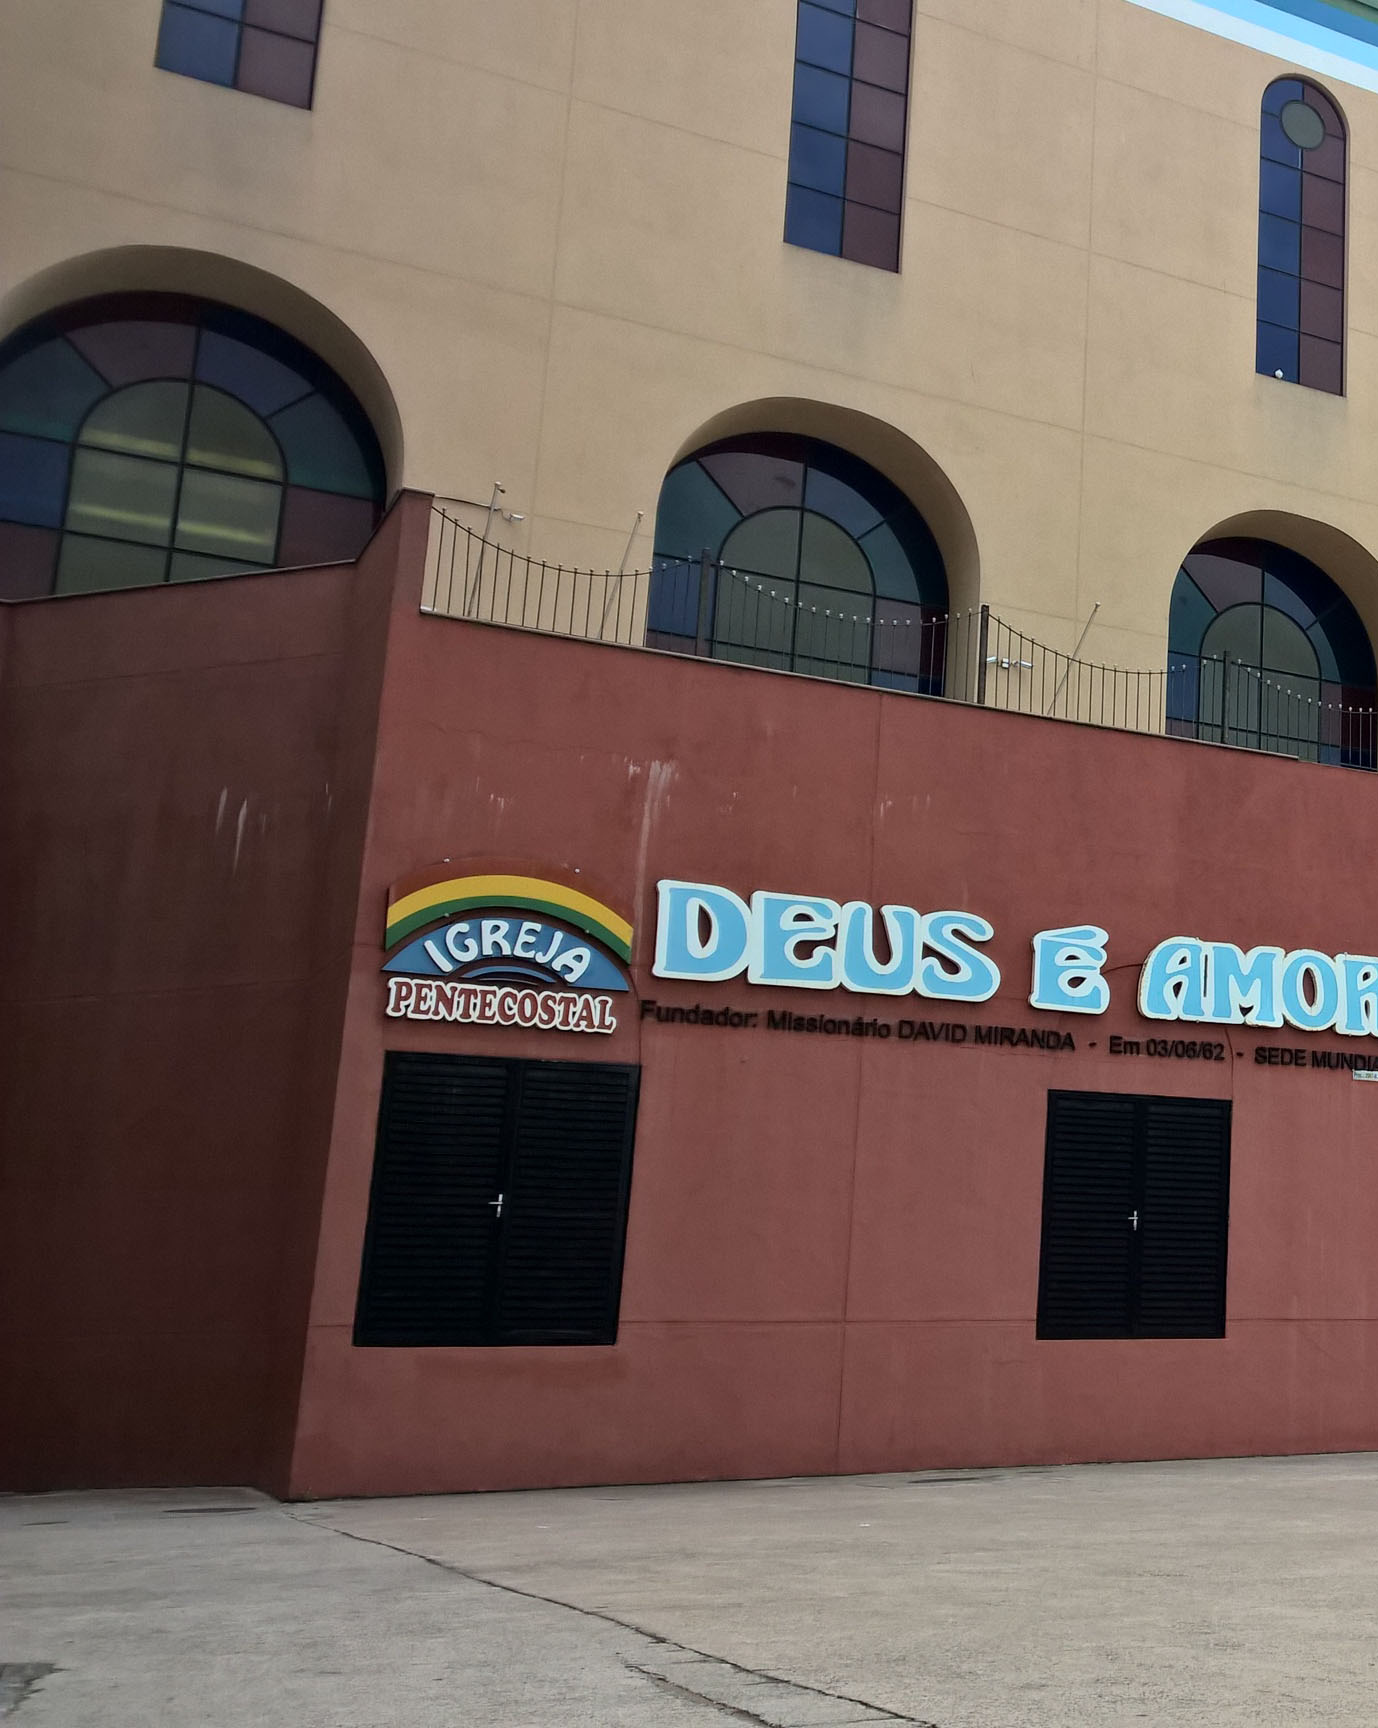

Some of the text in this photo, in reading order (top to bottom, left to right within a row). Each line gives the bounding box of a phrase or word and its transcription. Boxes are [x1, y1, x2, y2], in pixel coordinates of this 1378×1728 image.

[424, 920, 592, 983] IGREJA
[652, 879, 1001, 1003] DEUS
[387, 978, 617, 1034] PENTECOSTAL
[640, 1000, 758, 1028] Fundador:
[766, 1009, 892, 1038] Missionário
[897, 1020, 968, 1043] DAVID
[974, 1025, 1076, 1051] MIRANDA
[1109, 1035, 1140, 1056] Em
[1146, 1038, 1226, 1061] 03/06/62
[1254, 1046, 1307, 1067] SEDE
